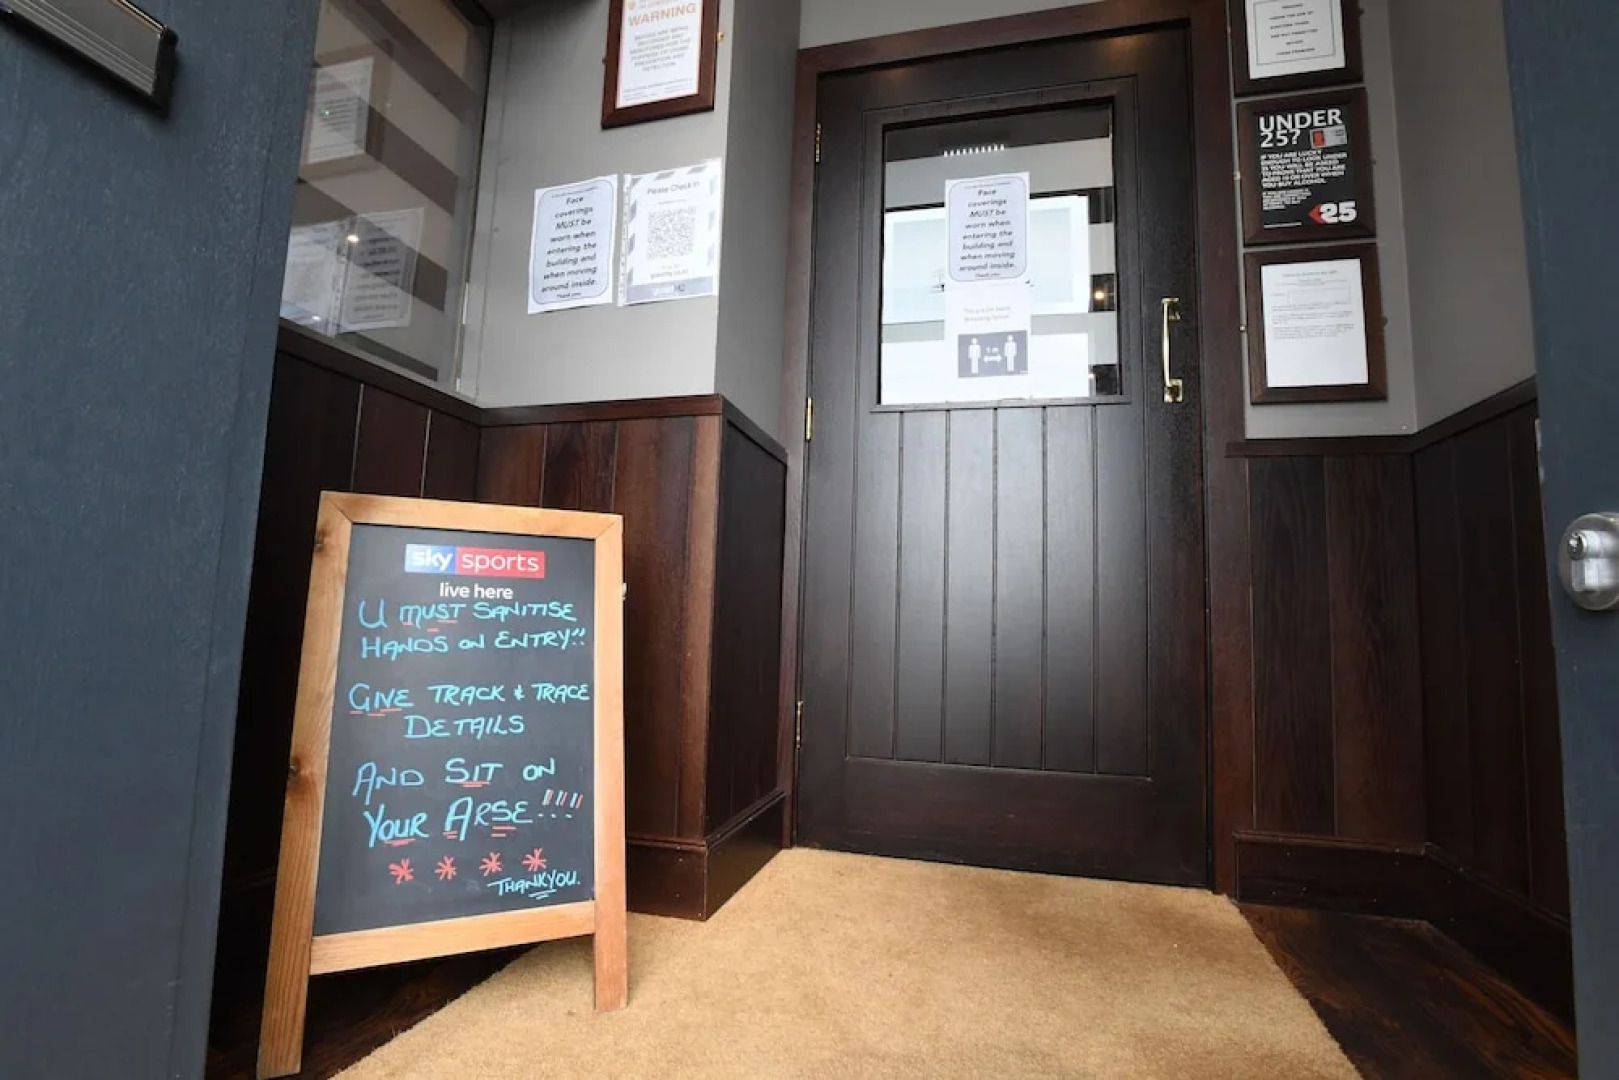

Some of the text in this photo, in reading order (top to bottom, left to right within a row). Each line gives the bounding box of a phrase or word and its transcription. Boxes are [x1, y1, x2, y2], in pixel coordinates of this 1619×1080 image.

[628, 3, 696, 26] WARNING
[1259, 108, 1342, 132] UNDER
[1260, 129, 1300, 148] 25?
[647, 186, 669, 195] Please
[670, 182, 692, 192] Check
[566, 196, 583, 205] Face
[967, 199, 1007, 208] coverings
[555, 207, 593, 219] coverings
[969, 208, 1006, 217] MUST be
[1320, 201, 1357, 223] 25
[555, 218, 591, 230] MUST be
[988, 220, 1010, 228] when
[550, 231, 596, 242] worn when
[962, 232, 997, 240] entering
[547, 242, 596, 255] entering the
[962, 242, 995, 250] building
[546, 256, 578, 267] building
[960, 251, 1015, 261] when moving
[544, 266, 597, 279] when moving
[959, 263, 988, 271] around
[541, 282, 568, 292] around
[412, 546, 540, 573] sky sports
[439, 582, 514, 600] live here
[358, 599, 387, 629] U
[472, 601, 578, 623] SANITISE
[361, 635, 449, 661] HANDS
[458, 634, 486, 650] ON
[348, 682, 590, 712] GIVE TRACK & TRACE
[402, 714, 525, 739] DETAILS
[352, 757, 556, 806] AND SIT ON
[363, 803, 430, 848] YOUR
